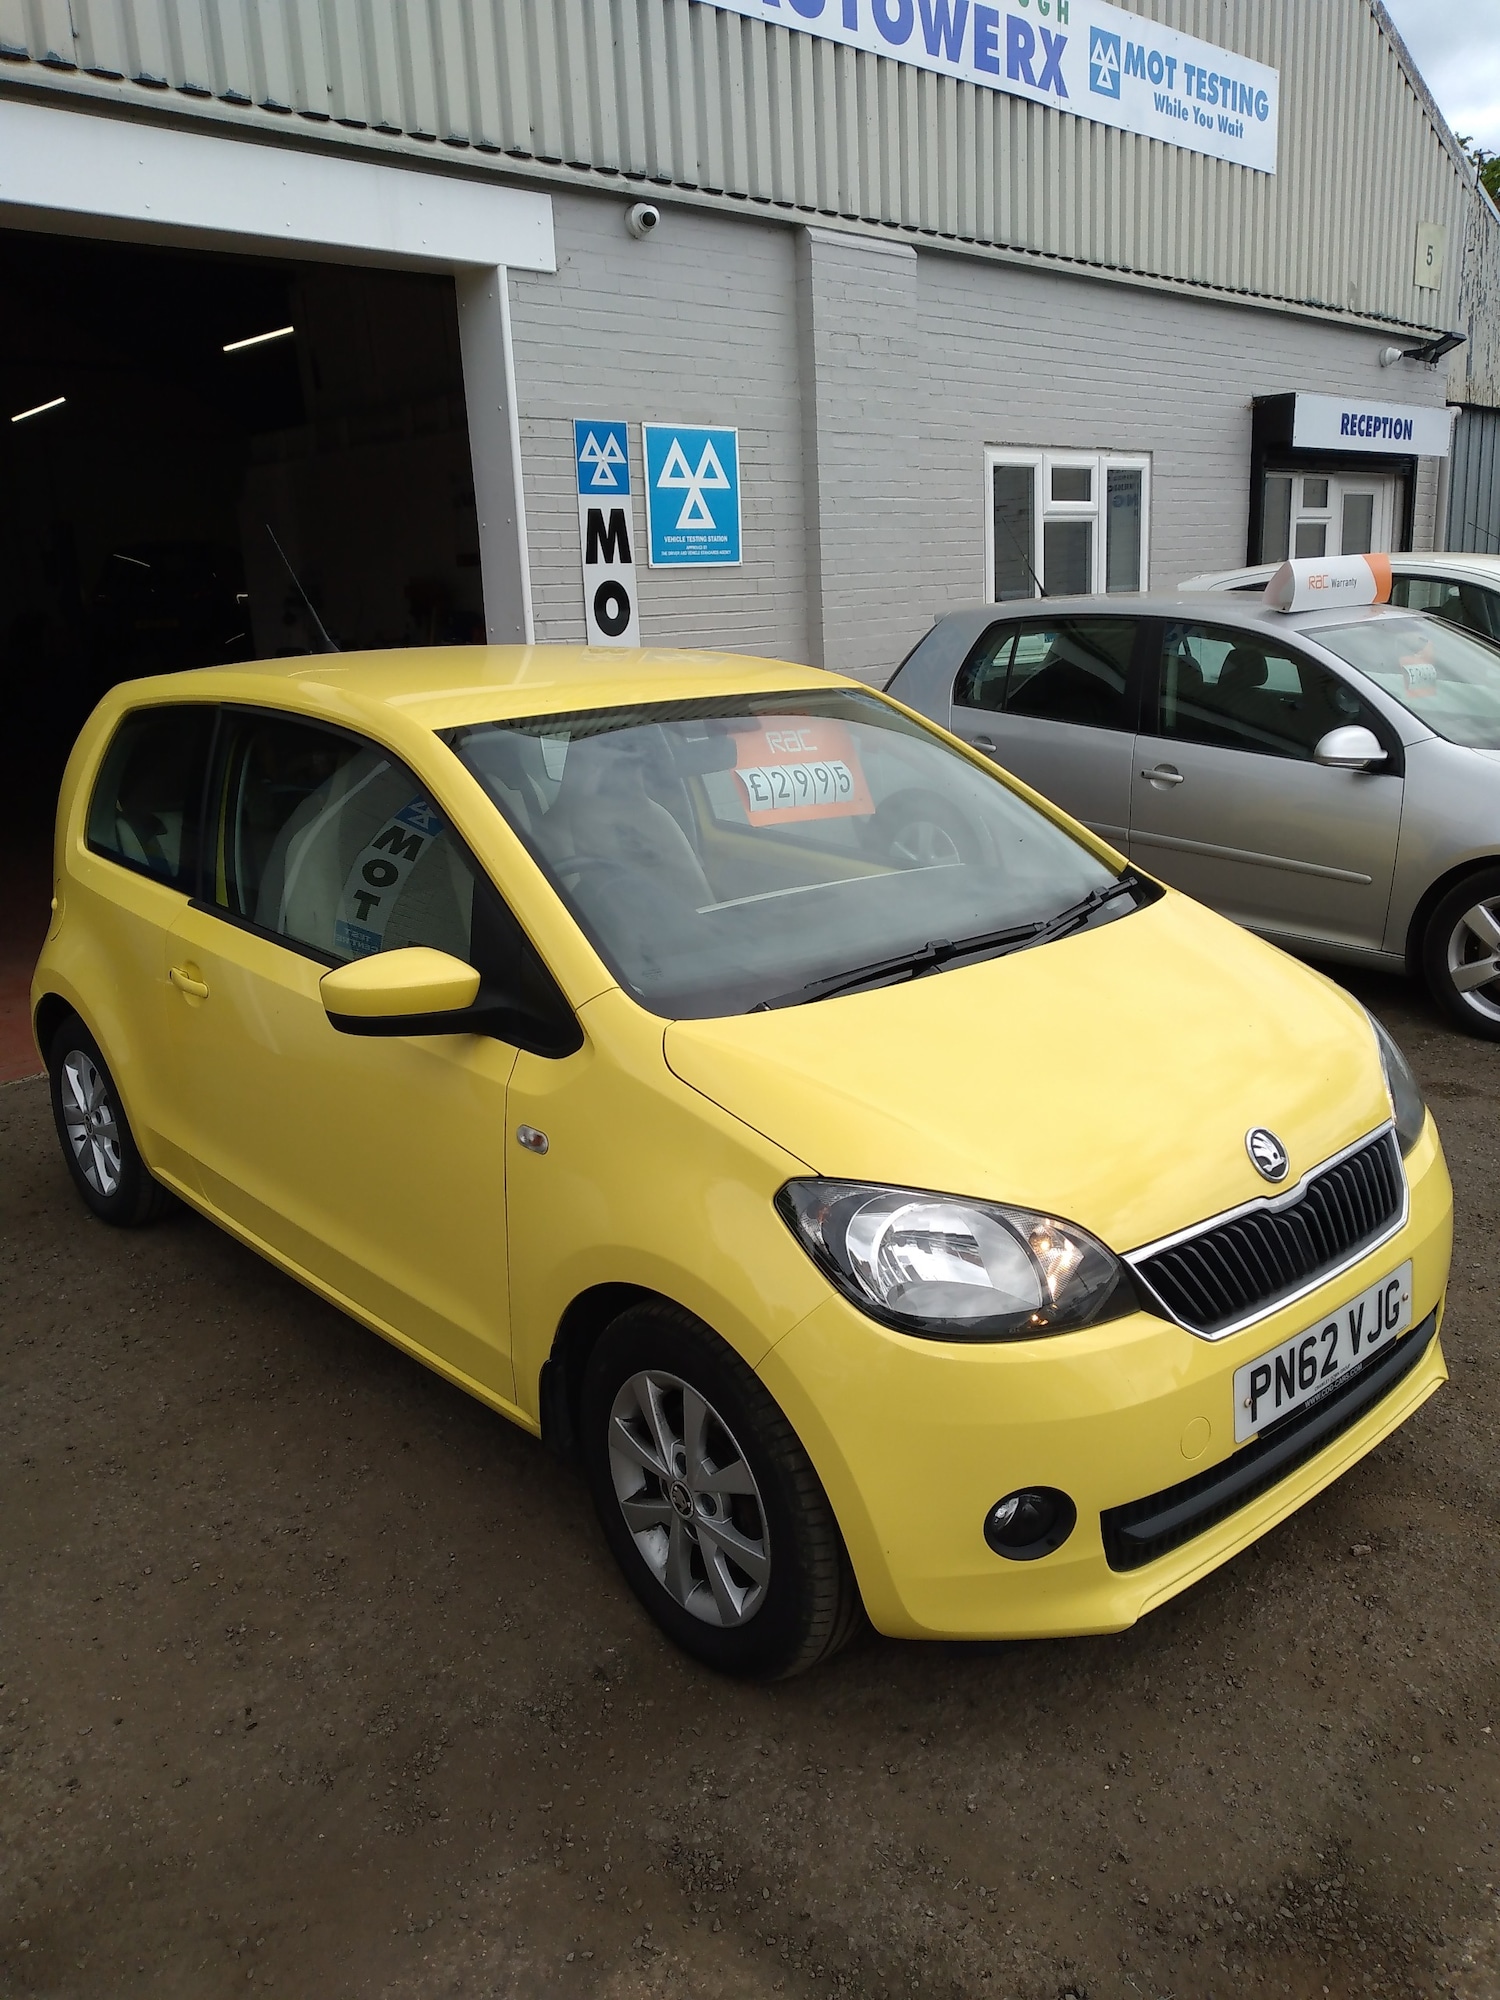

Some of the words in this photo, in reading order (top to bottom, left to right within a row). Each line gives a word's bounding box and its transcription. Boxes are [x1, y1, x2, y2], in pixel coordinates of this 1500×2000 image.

[1124, 41, 1177, 90] MOT
[1184, 62, 1269, 122] TESTING
[1154, 91, 1189, 121] While
[1192, 105, 1214, 130] You
[1217, 114, 1245, 139] Wait
[1425, 244, 1434, 266] 5
[1340, 412, 1413, 441] RECEPTION
[663, 535, 686, 543] VEHICLE
[686, 535, 707, 543] TESTING
[708, 535, 728, 543] STATION
[1330, 578, 1357, 589] Warranty
[749, 766, 850, 802] £2995
[1250, 1322, 1338, 1423] PN62
[1349, 1279, 1400, 1356] VJG
